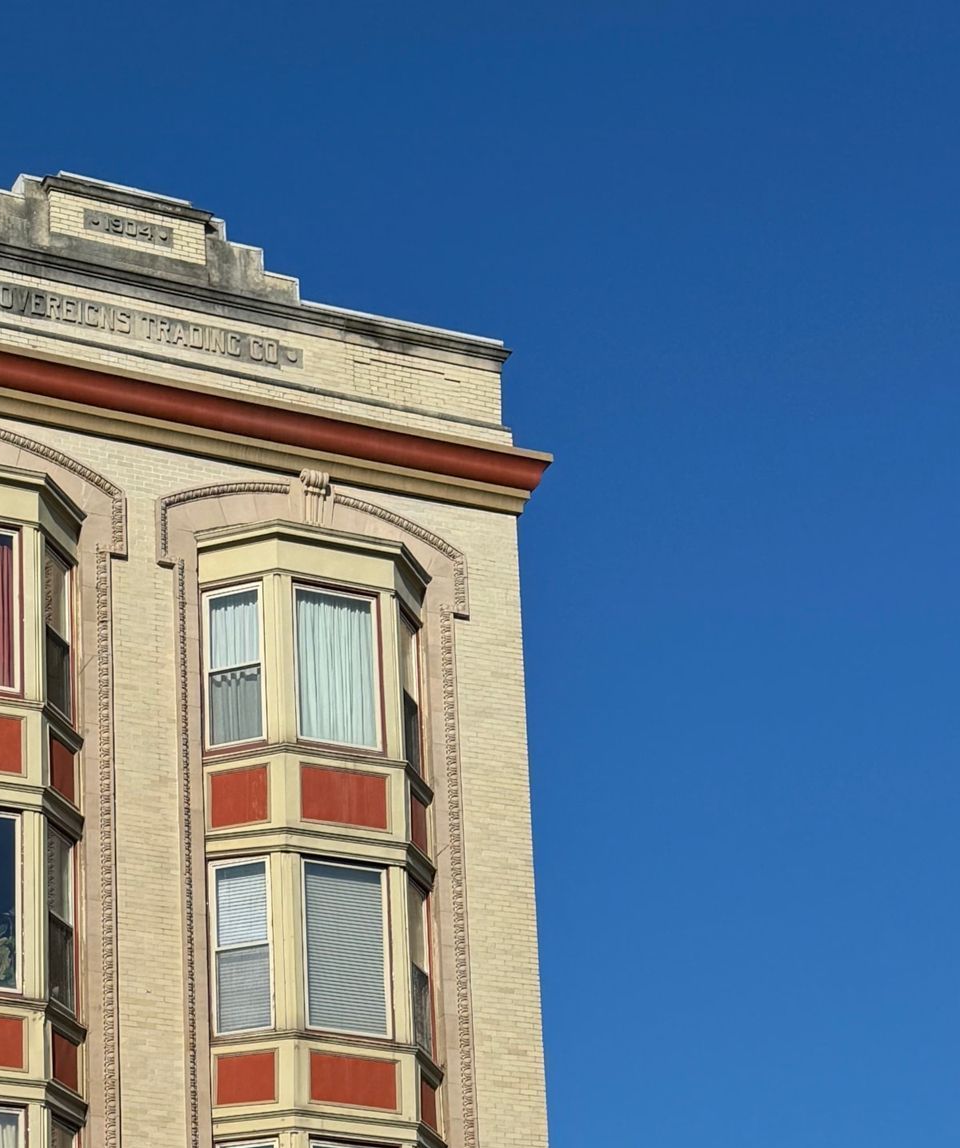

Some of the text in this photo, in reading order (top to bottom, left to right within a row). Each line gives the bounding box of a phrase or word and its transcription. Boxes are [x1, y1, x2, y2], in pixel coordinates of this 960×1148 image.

[103, 215, 154, 241] 1904
[141, 315, 242, 358] TRADING
[248, 337, 279, 365] CO
